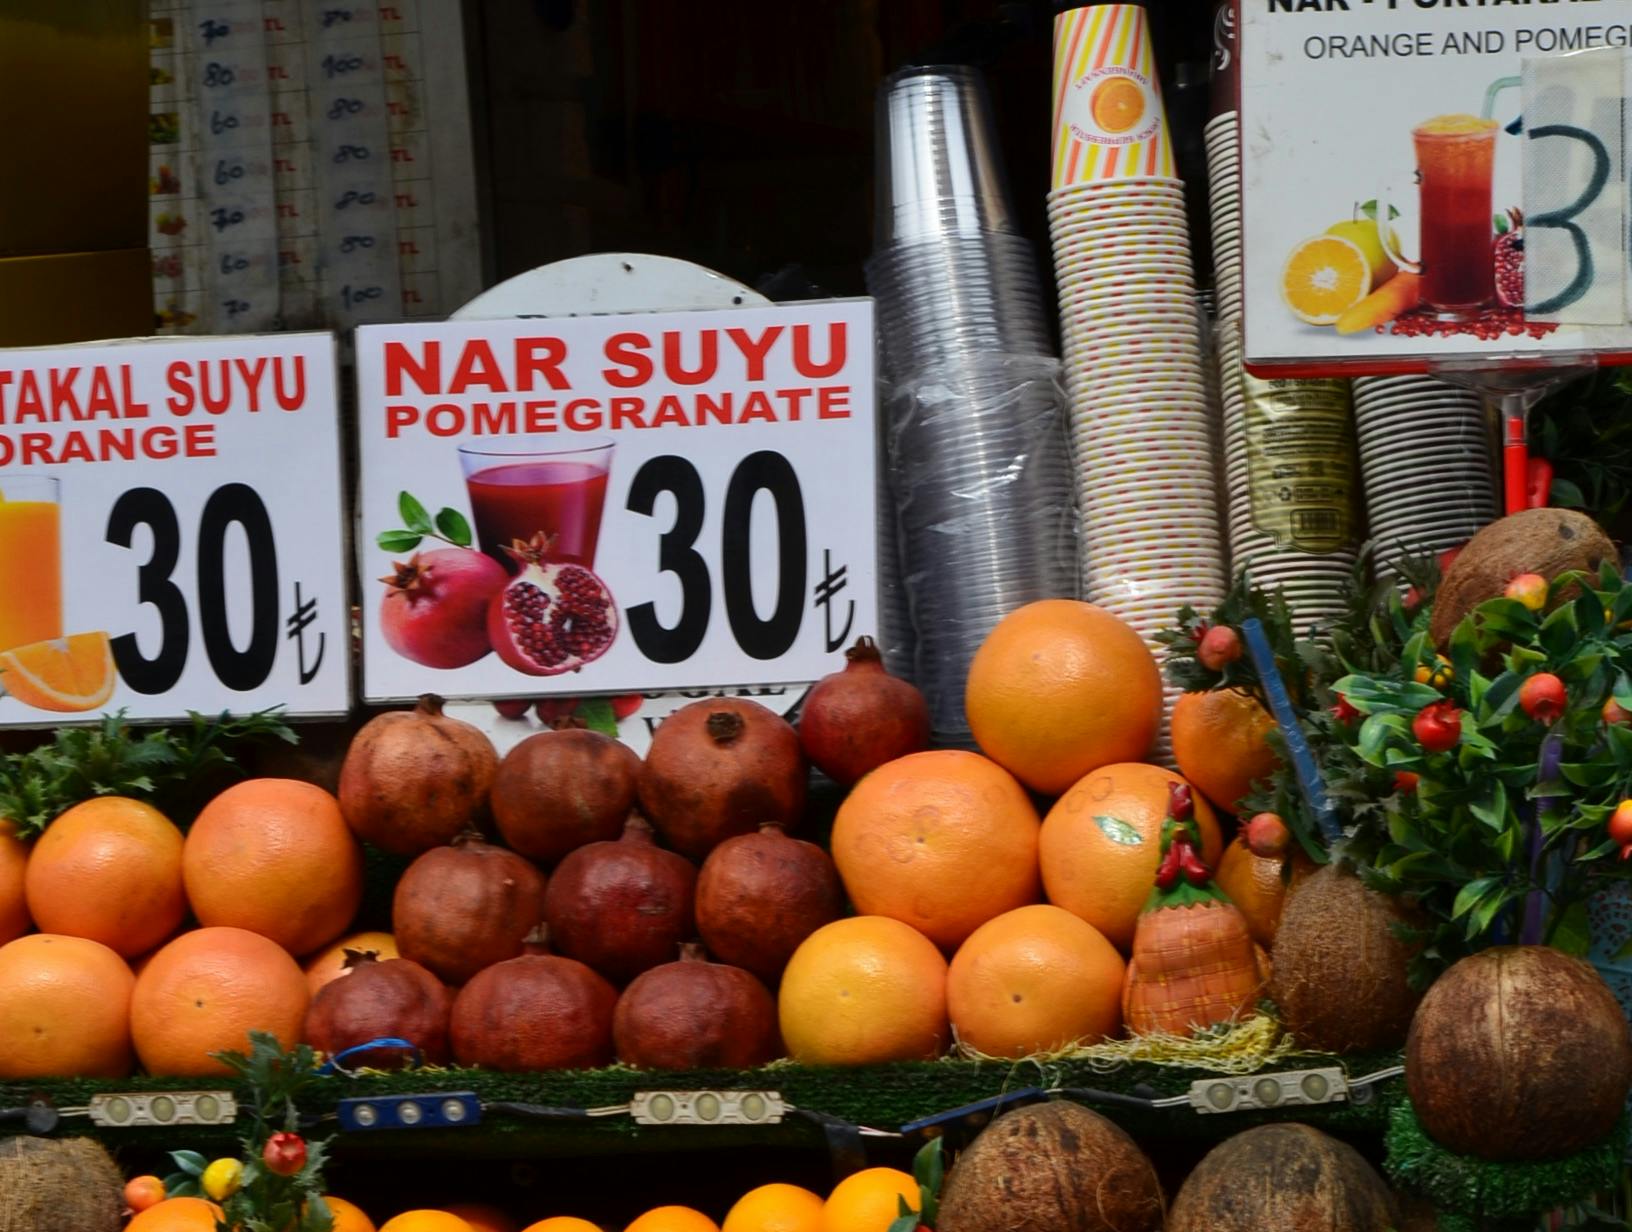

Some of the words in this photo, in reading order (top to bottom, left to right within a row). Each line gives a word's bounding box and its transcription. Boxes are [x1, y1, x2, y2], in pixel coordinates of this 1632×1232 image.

[1304, 32, 1433, 59] ORANGE
[1441, 30, 1505, 55] AND
[1515, 24, 1632, 53] POMEG
[166, 355, 305, 416] SUYU
[384, 336, 571, 396] NAR
[602, 322, 848, 389] SUYU
[385, 386, 852, 438] POMEGRANATE
